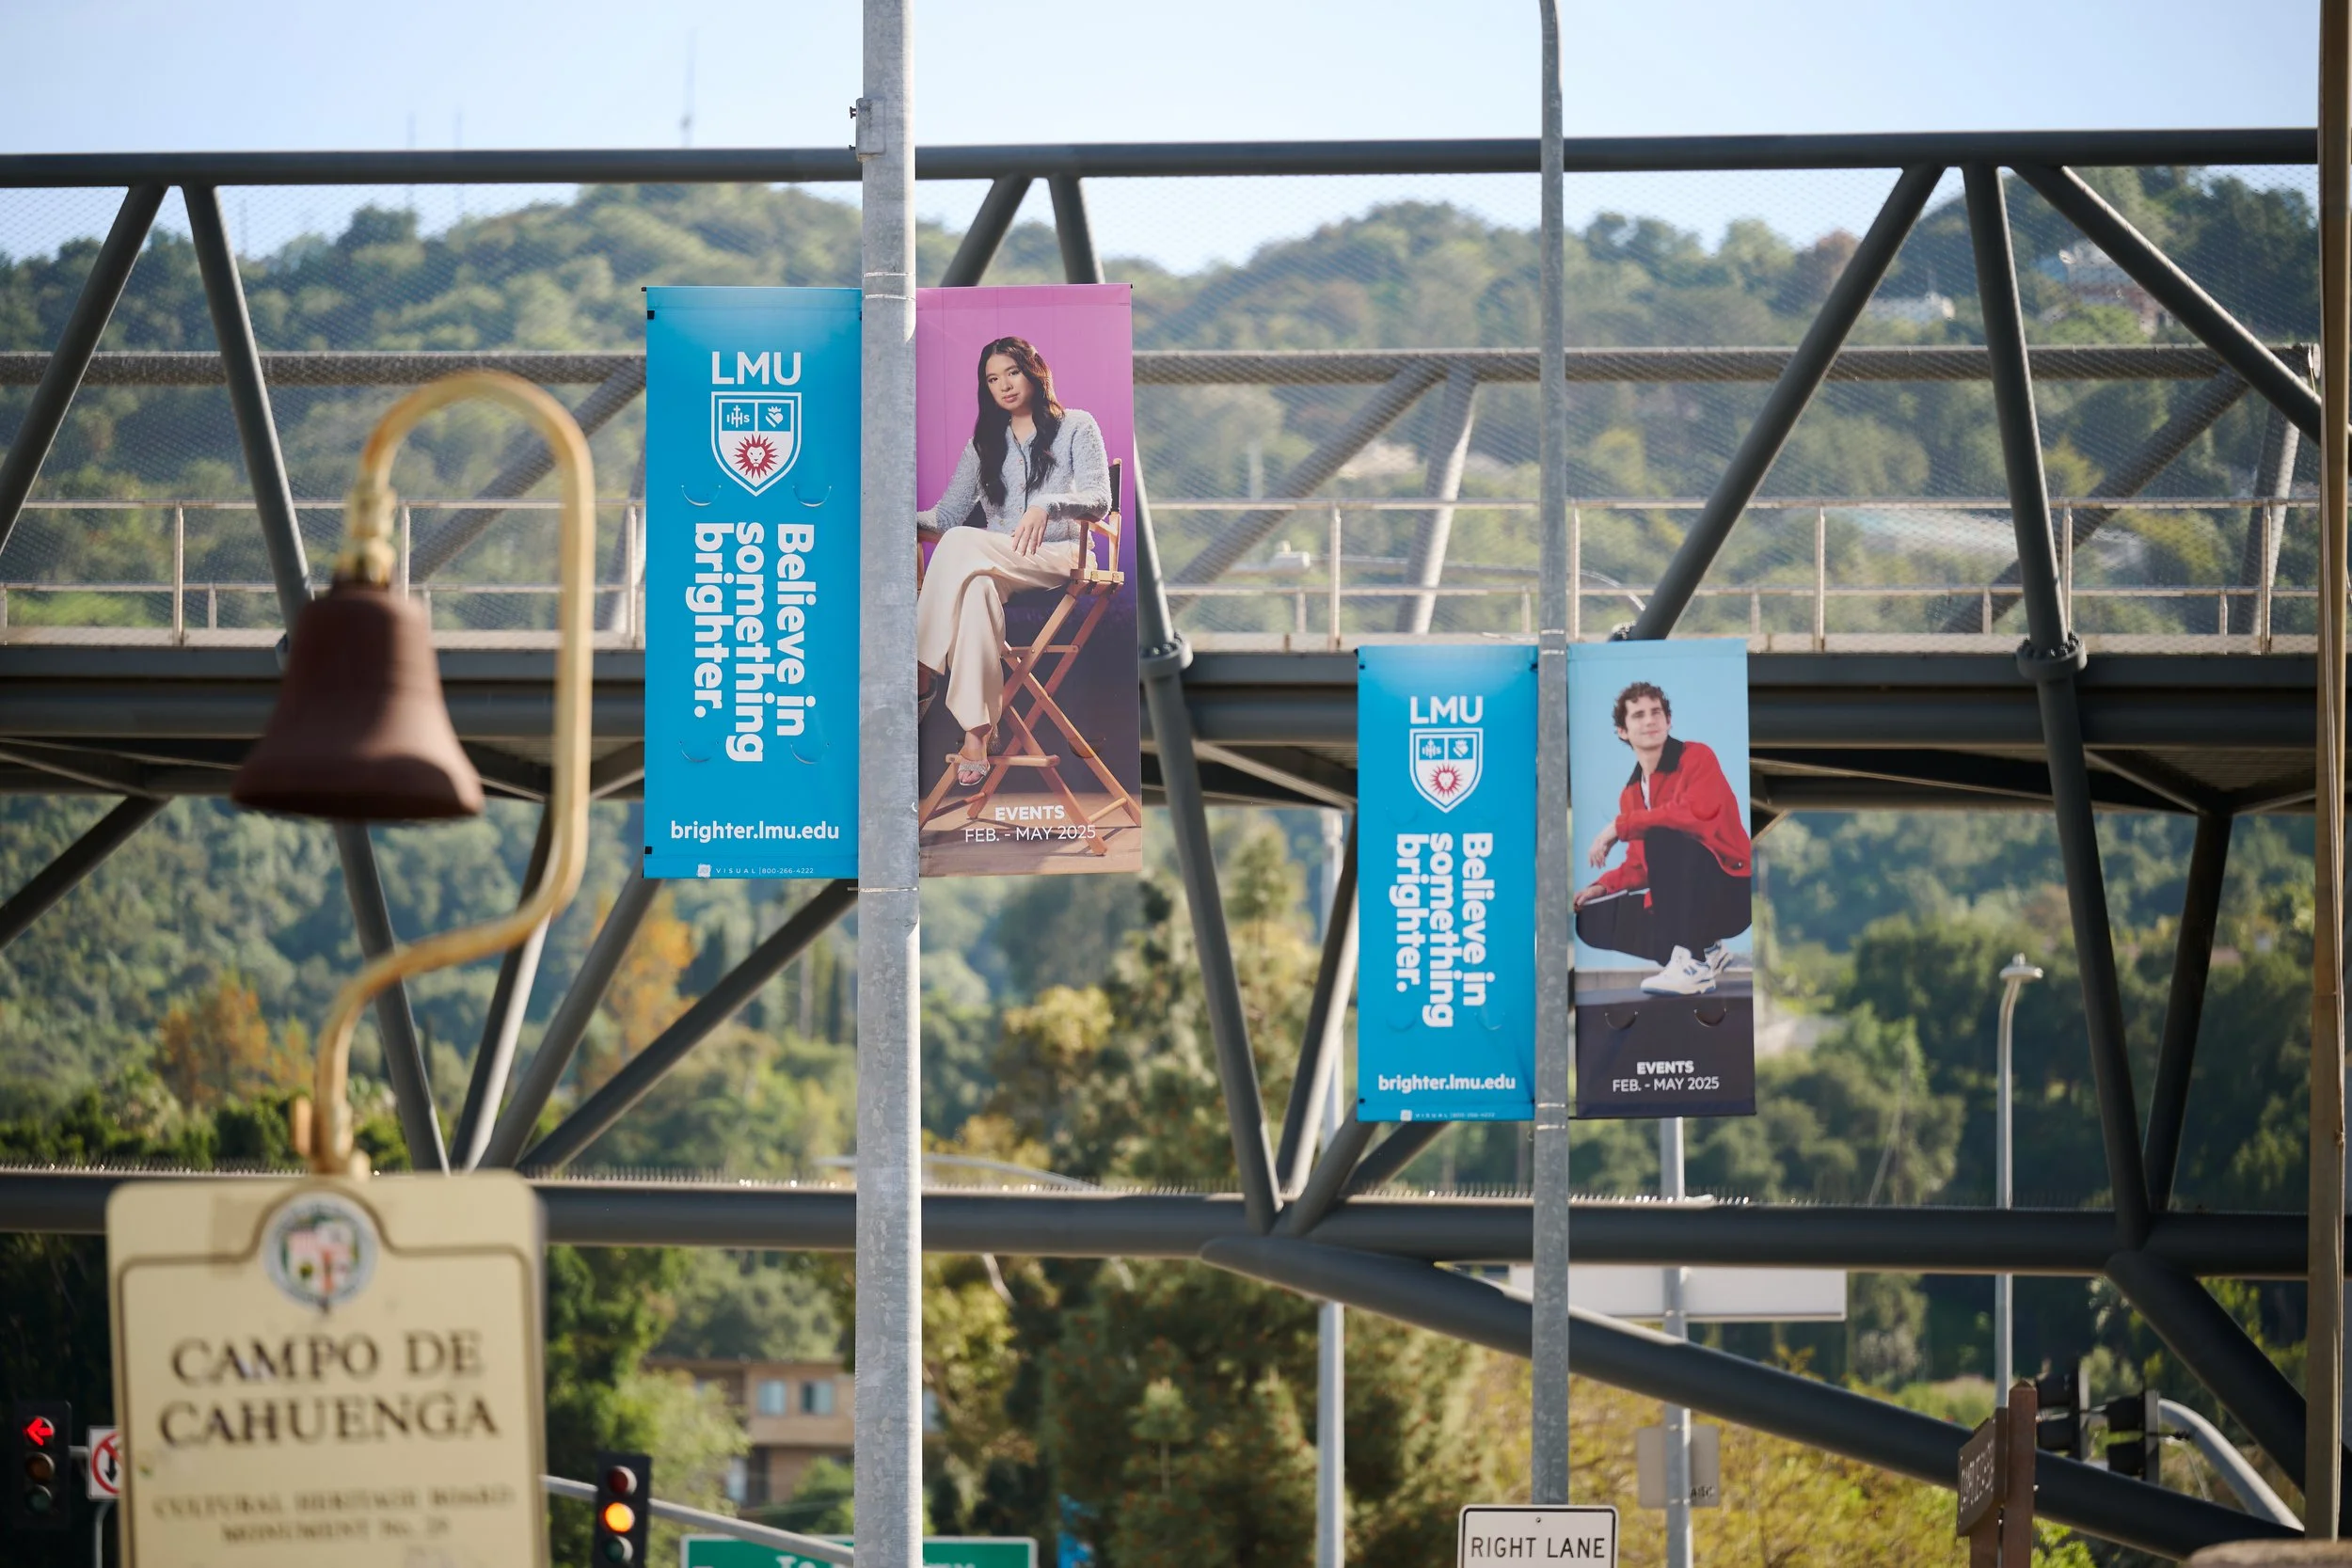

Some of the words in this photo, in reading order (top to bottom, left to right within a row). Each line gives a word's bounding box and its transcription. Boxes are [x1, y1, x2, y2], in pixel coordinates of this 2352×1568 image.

[711, 351, 802, 386] LMU
[685, 523, 734, 718] brighter.
[776, 524, 817, 684] Believe
[725, 522, 775, 762] something
[776, 695, 816, 736] in
[1410, 695, 1484, 724] LMU
[994, 805, 1066, 821] EVENTS
[671, 820, 840, 843] brighter.lmu.edu
[965, 828, 1000, 843] FEB.
[1016, 826, 1053, 841] MAY
[1057, 825, 1096, 840] 2025
[1389, 833, 1430, 992] brighter.
[1462, 832, 1495, 965] Believe
[1422, 832, 1464, 1028] something
[1462, 972, 1496, 1006] in
[1378, 1073, 1517, 1094] brighter.lmu.edu
[1613, 1079, 1642, 1092] FEB.
[1654, 1078, 1684, 1091] MAY
[1688, 1076, 1720, 1090] 2025
[1637, 1060, 1694, 1075] EVENTS
[171, 1333, 379, 1385] CAMPO
[404, 1329, 483, 1377] DE
[158, 1392, 499, 1447] CAHUENGA
[1471, 1537, 1536, 1558] RIGHT
[1547, 1537, 1605, 1558] LANE
